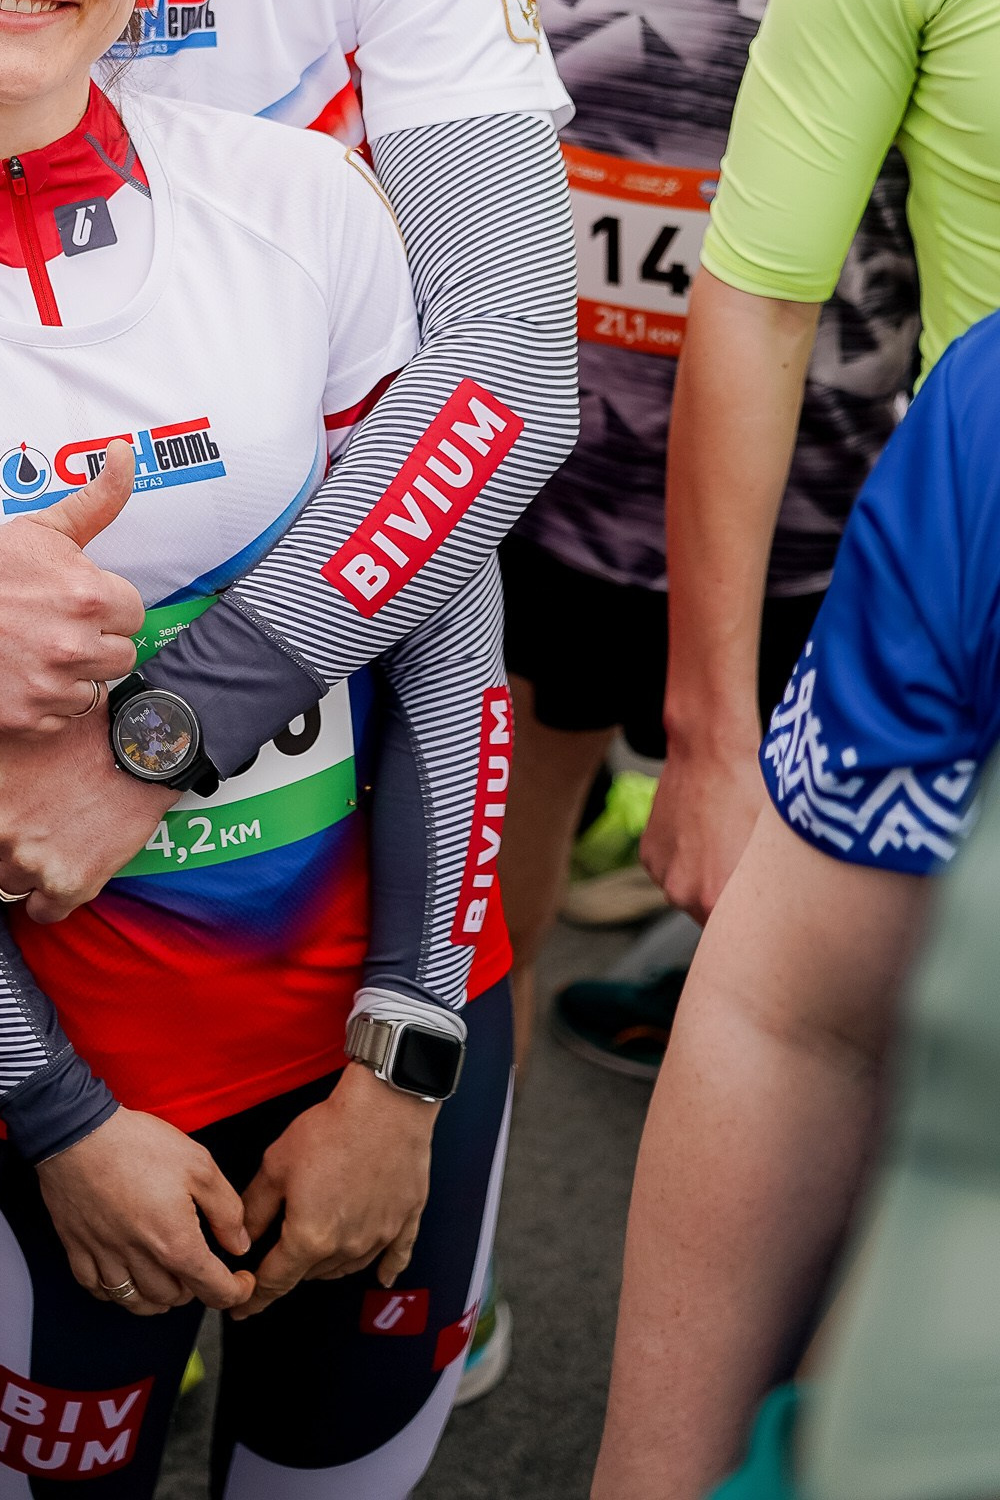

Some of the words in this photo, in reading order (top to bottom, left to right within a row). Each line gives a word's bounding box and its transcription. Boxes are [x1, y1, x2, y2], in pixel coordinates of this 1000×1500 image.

[590, 215, 691, 297] 14
[339, 396, 508, 602] BIVIUM
[461, 699, 511, 933] BIVIUM
[0, 1381, 143, 1430] BIV
